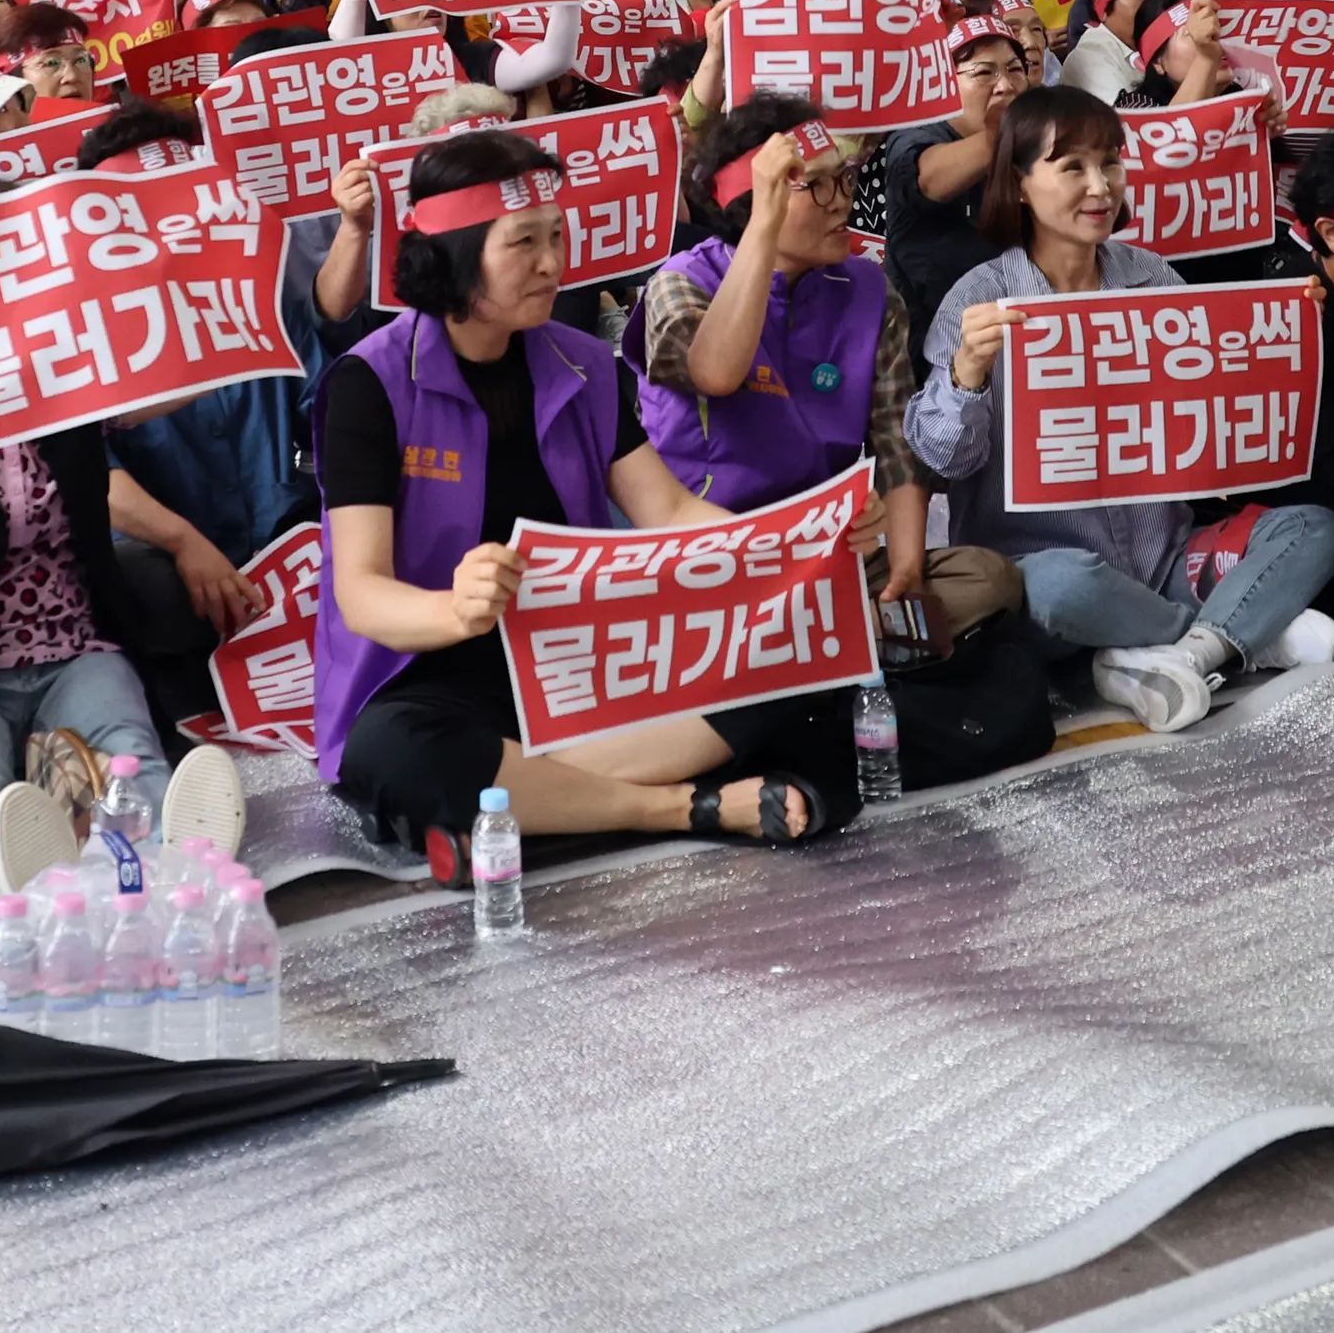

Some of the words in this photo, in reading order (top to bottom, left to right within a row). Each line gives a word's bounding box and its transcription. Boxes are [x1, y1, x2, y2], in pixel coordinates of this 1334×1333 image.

[148, 52, 220, 95] 완주를
[751, 40, 962, 117] 물러가라!
[500, 170, 555, 209] 통합
[1034, 390, 1300, 486] 물러가라!
[529, 578, 843, 719] 물러가라!
